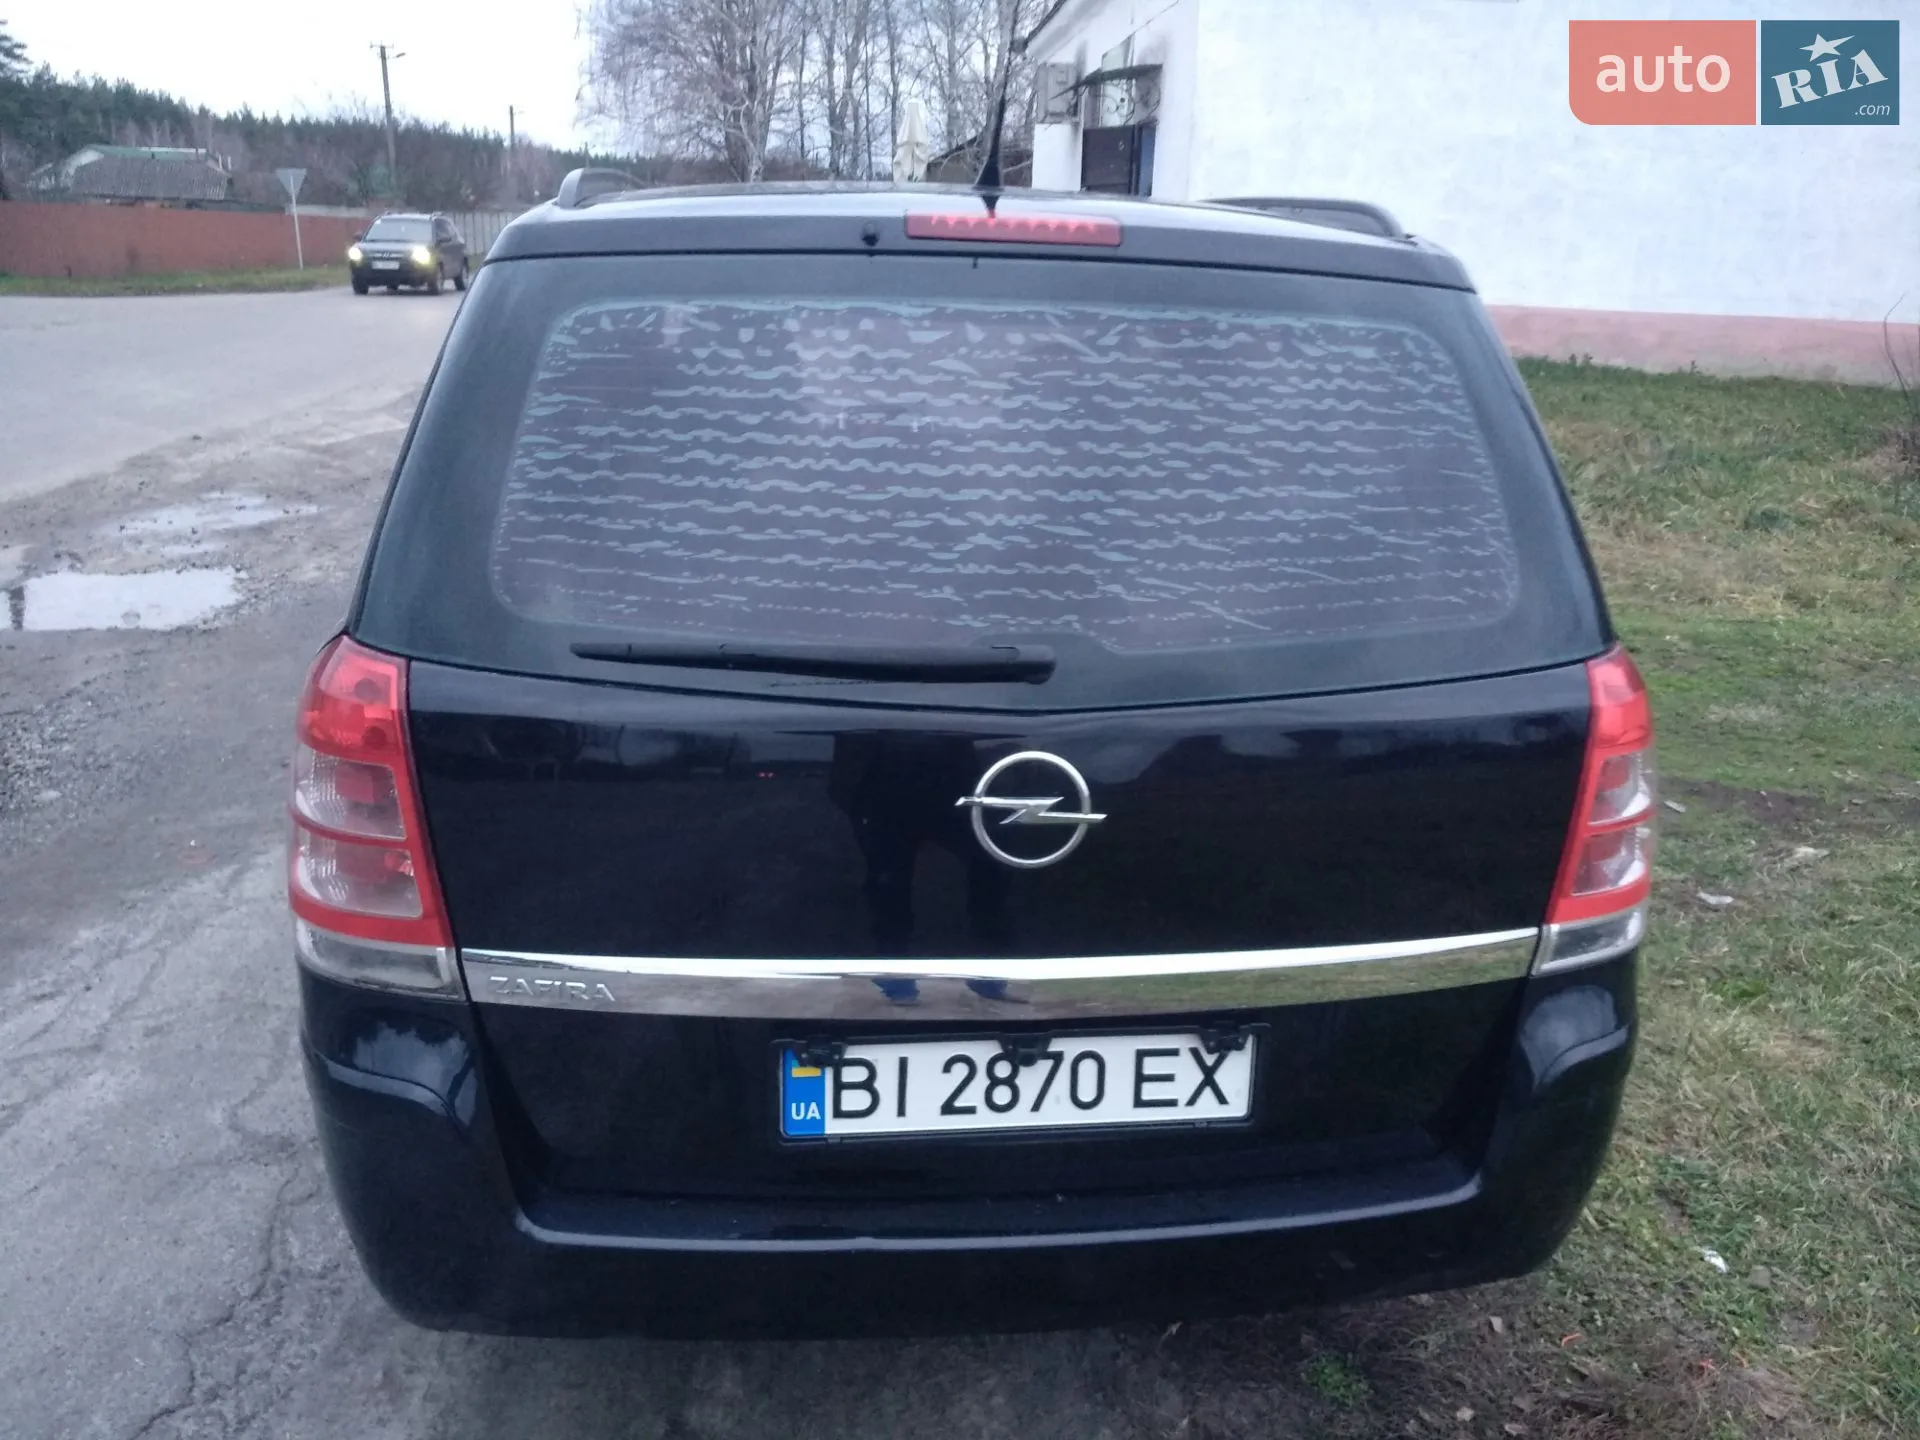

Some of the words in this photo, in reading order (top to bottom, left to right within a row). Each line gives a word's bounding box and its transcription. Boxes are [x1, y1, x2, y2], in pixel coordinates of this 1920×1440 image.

[489, 975, 616, 1002] ZAFIRA
[832, 1055, 907, 1119] BI
[940, 1048, 1106, 1116] 2870
[1132, 1046, 1230, 1109] EX
[791, 1102, 821, 1121] UA
